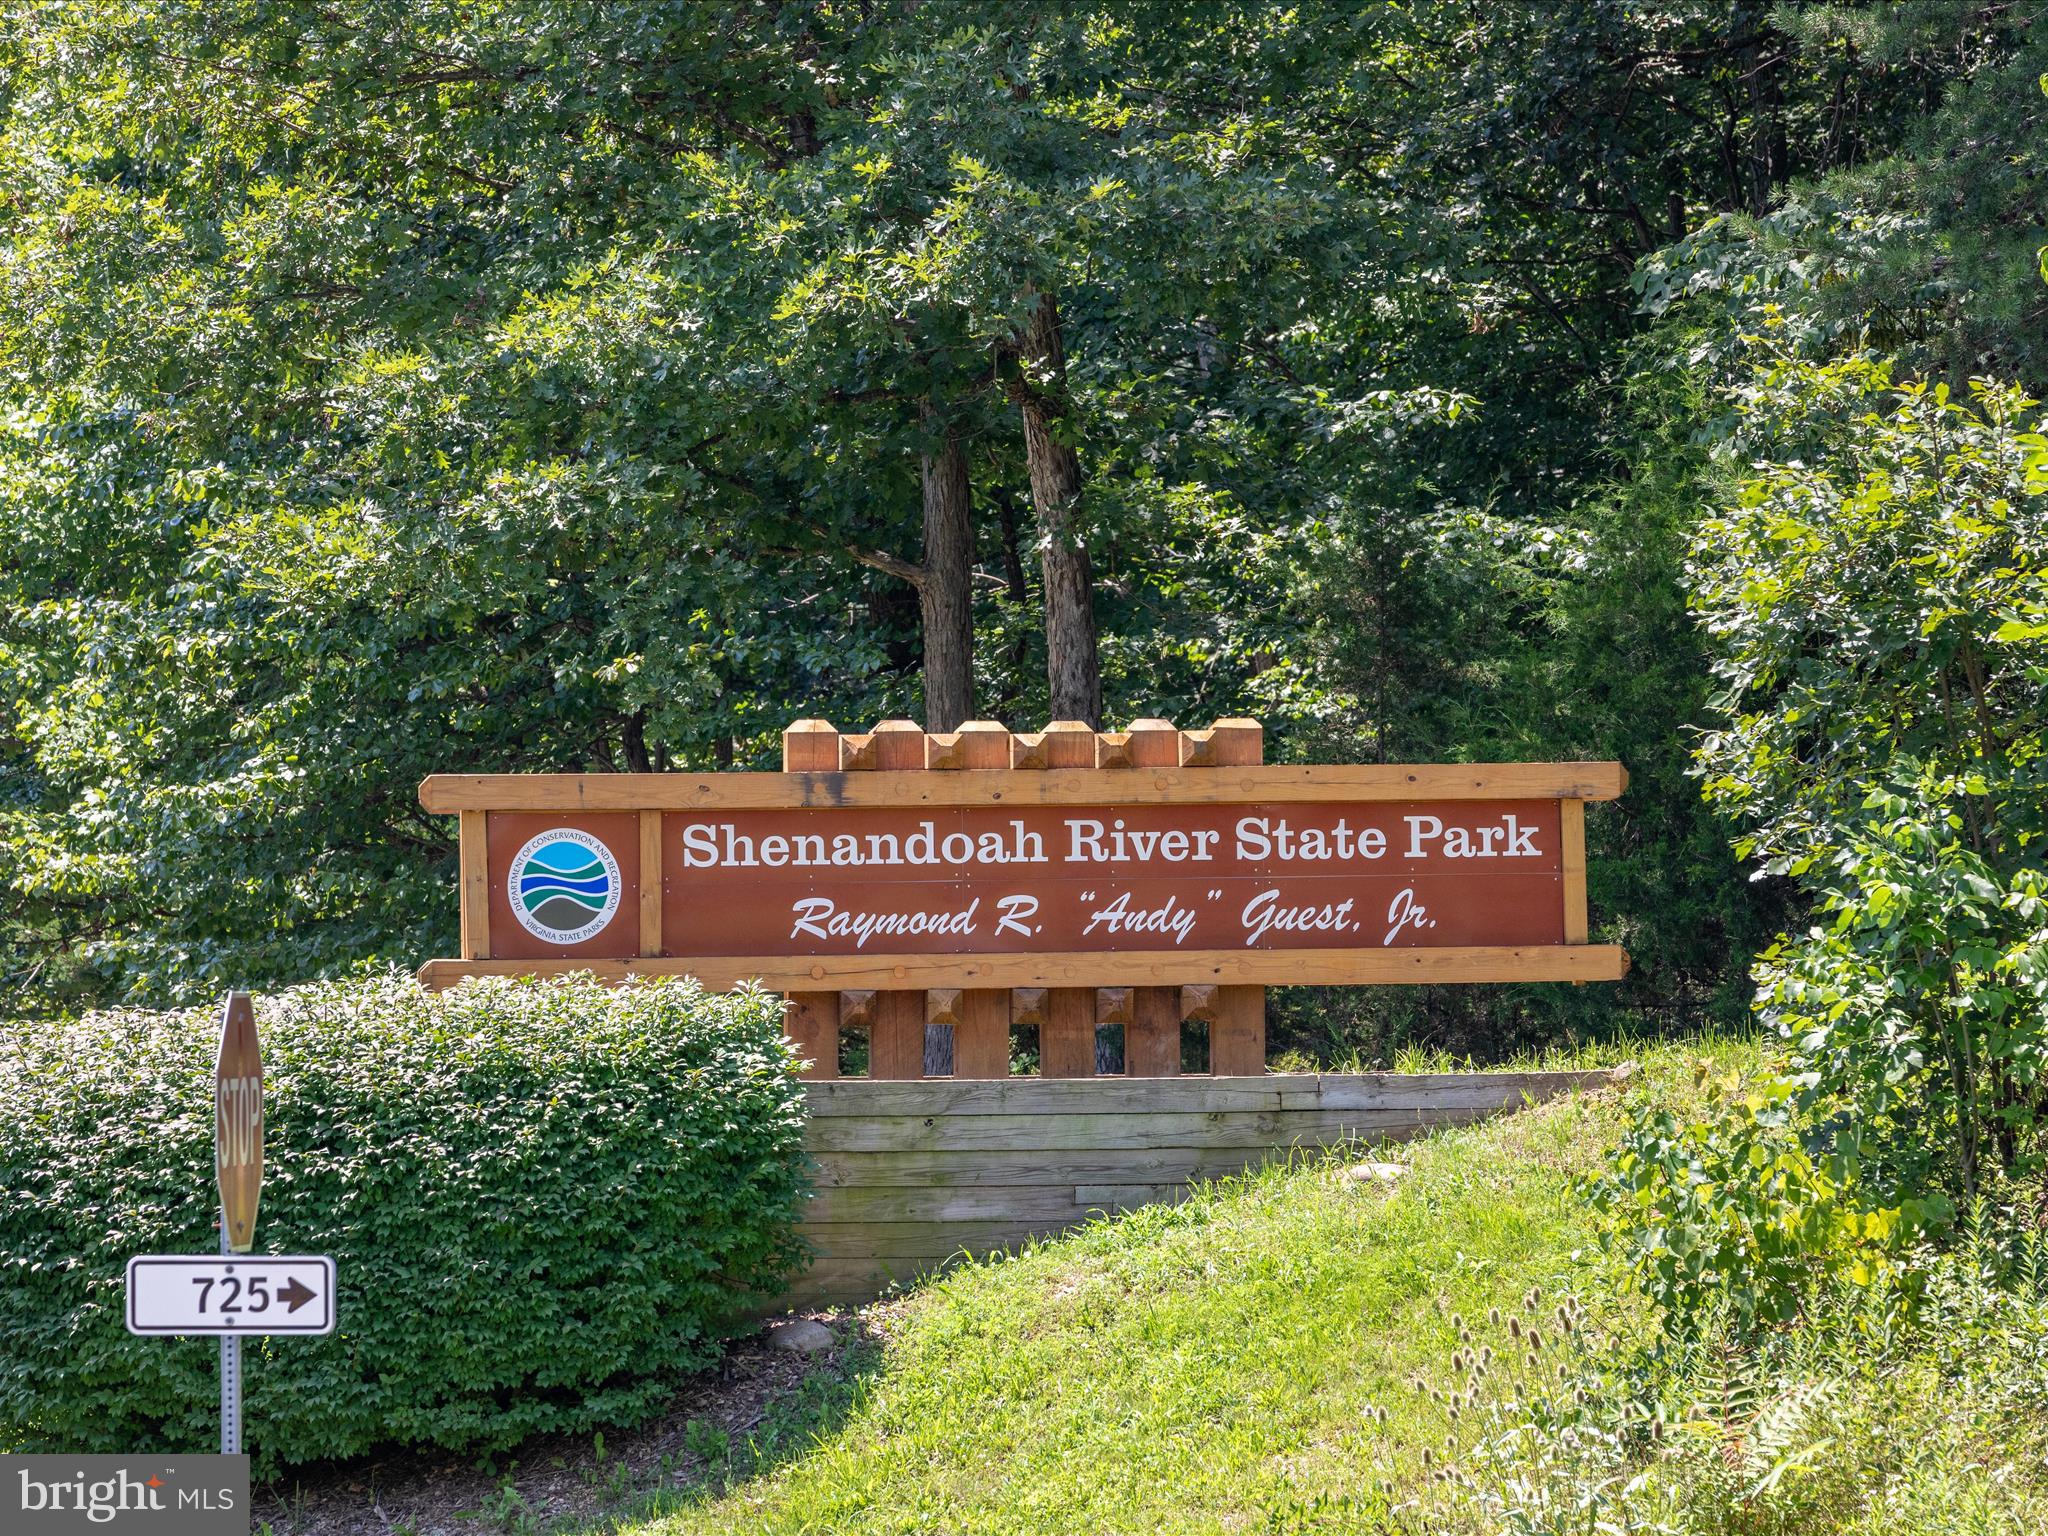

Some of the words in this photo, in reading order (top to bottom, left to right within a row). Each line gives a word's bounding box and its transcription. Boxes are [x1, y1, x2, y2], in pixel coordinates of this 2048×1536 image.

[682, 820, 1048, 868] Shenandoah
[1064, 818, 1220, 863] River
[1235, 816, 1387, 861] State
[1403, 814, 1542, 859] Park
[510, 857, 524, 912] DEPARTMENT
[522, 846, 532, 858] OF
[531, 832, 594, 849] CONSERVATION
[593, 844, 610, 861] AND
[607, 860, 619, 912] RECREATION
[526, 918, 556, 940] VIRGINIA
[558, 932, 582, 941] STATE
[583, 919, 605, 936] PARKS
[790, 897, 979, 949] Raymond
[994, 894, 1042, 938] R.
[1383, 888, 1437, 946] Jr.
[219, 1076, 260, 1170] STOP
[192, 1277, 270, 1314] 725
